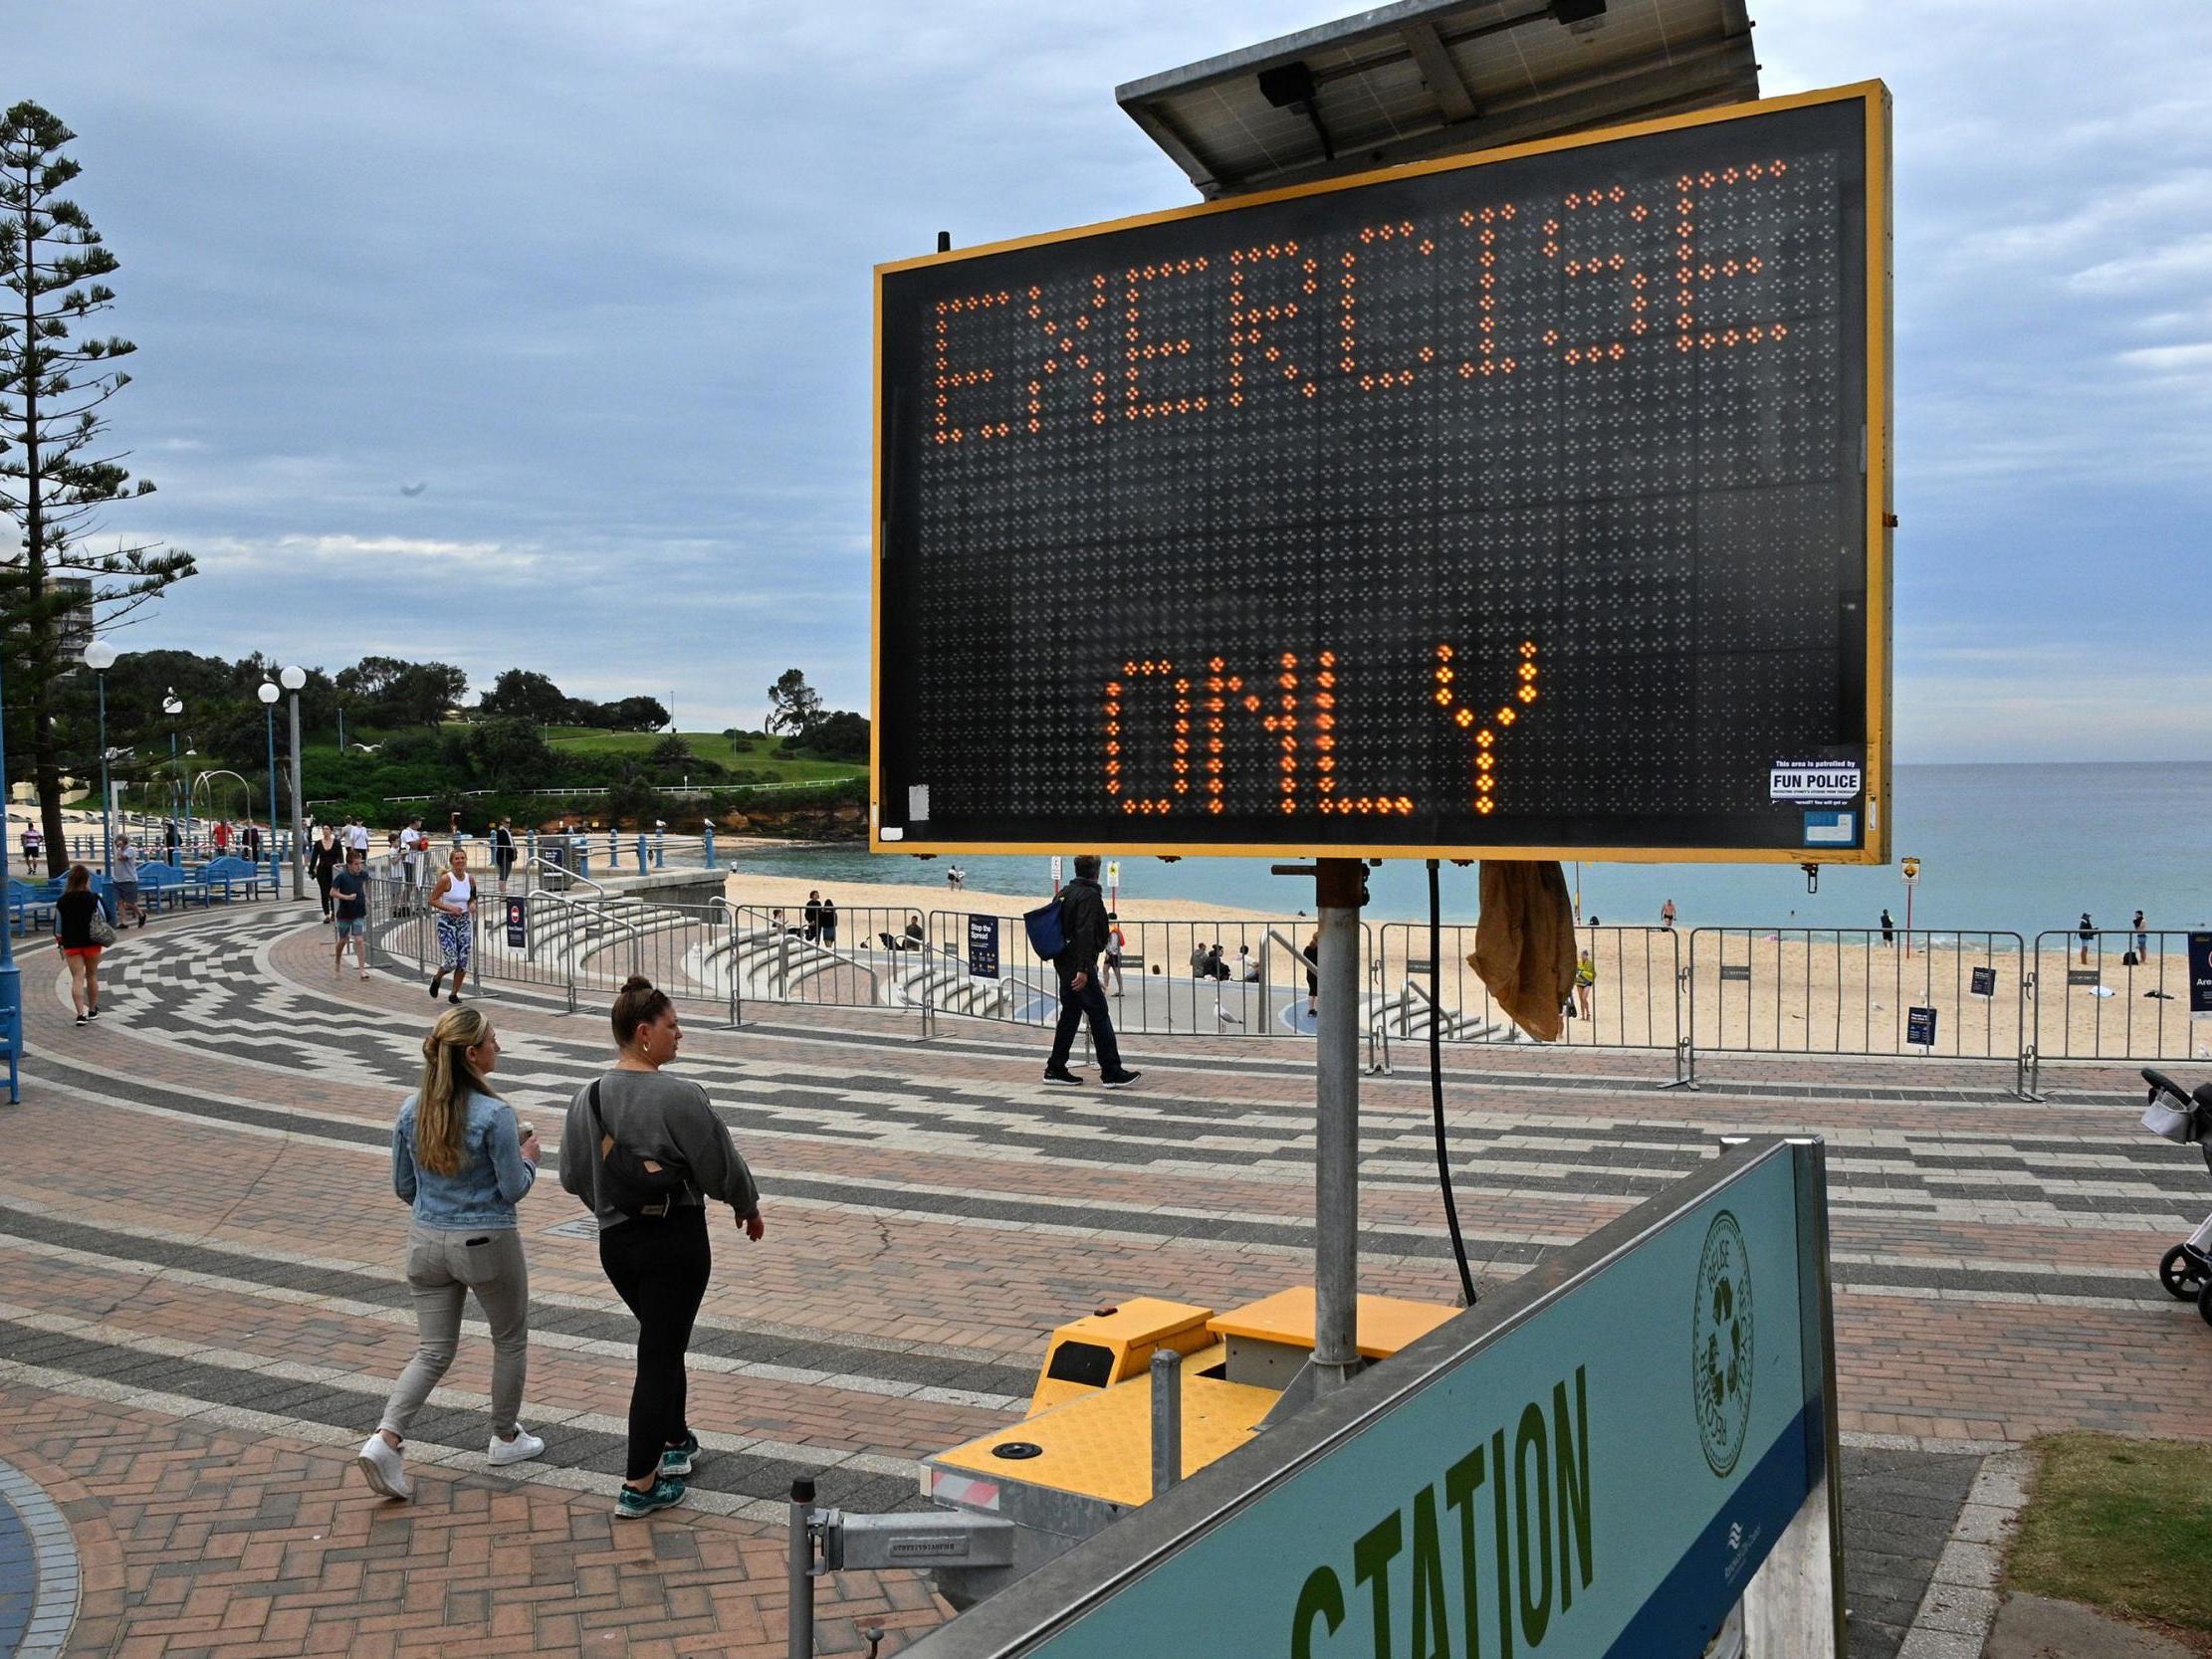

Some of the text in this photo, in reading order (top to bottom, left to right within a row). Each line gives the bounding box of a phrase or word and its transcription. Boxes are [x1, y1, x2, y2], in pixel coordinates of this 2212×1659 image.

[934, 158, 1790, 446] EXERCISE
[1105, 641, 1538, 814] ONLY
[1774, 774, 1858, 788] FUN POLICE
[971, 923, 982, 933] Stop
[971, 932, 989, 940] Spread
[1706, 1239, 1730, 1294] REUSE
